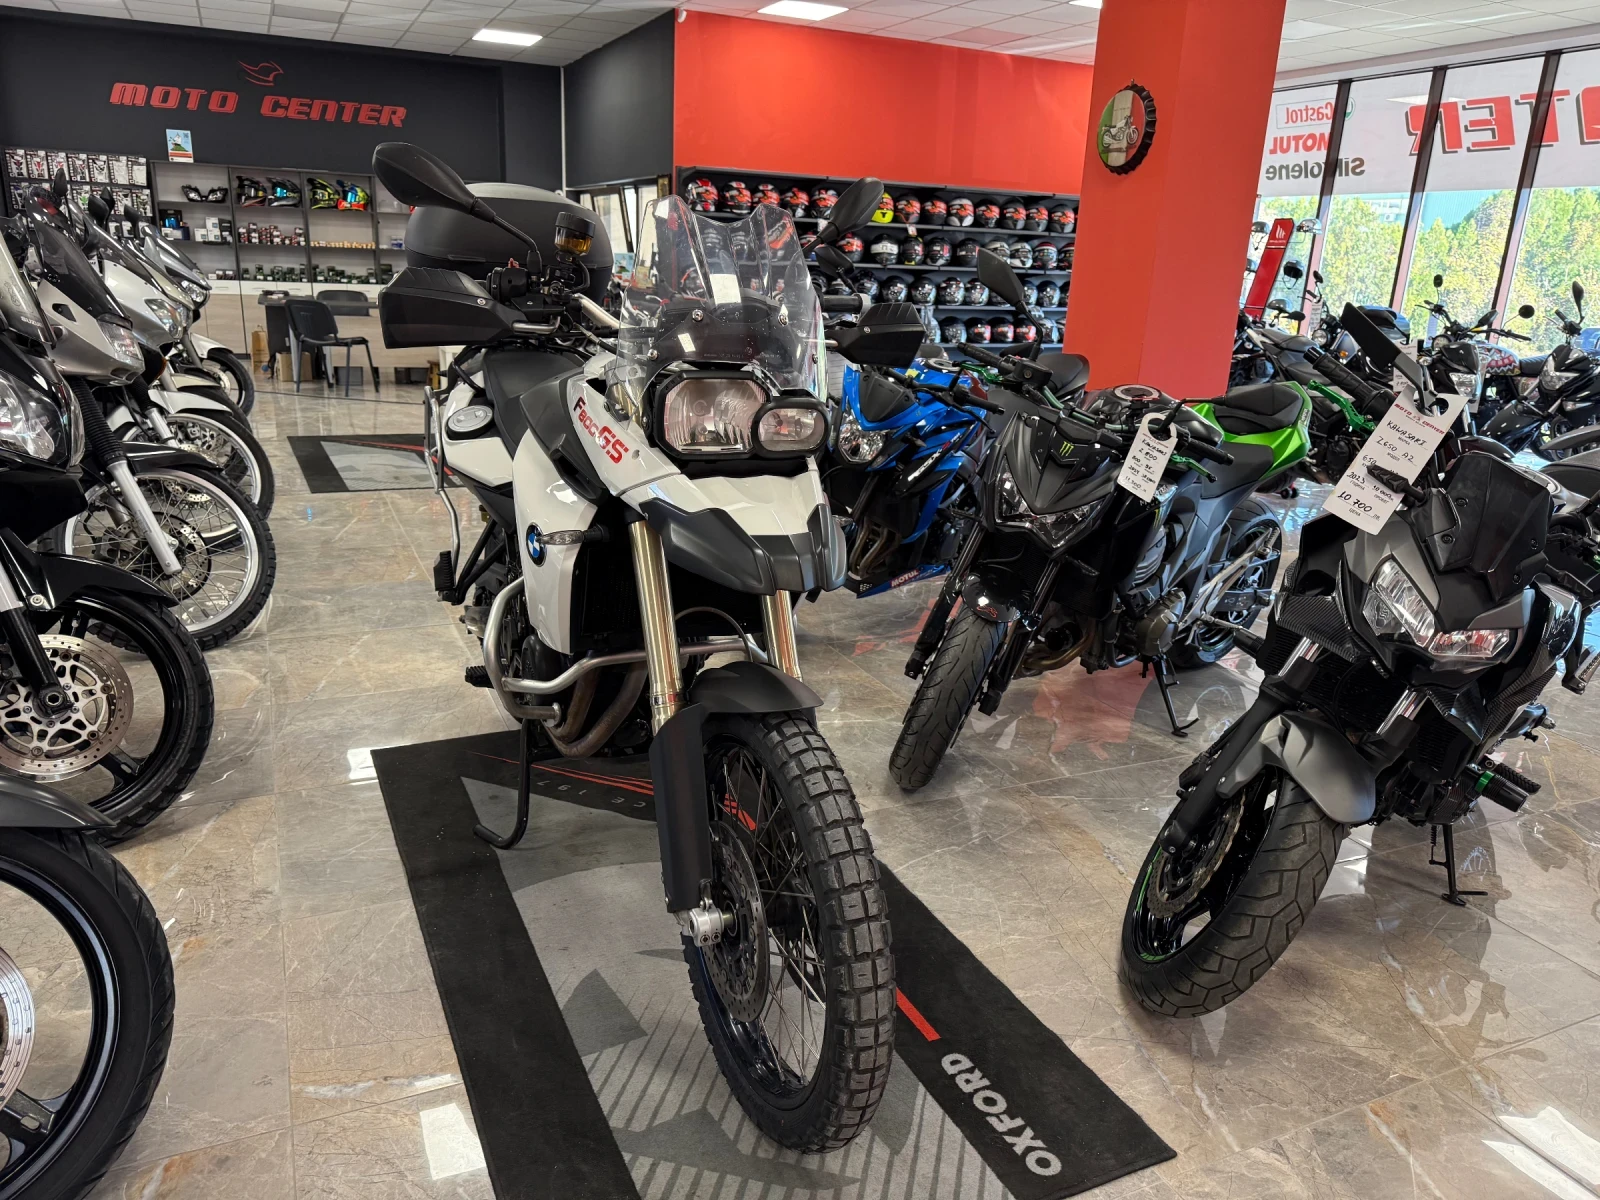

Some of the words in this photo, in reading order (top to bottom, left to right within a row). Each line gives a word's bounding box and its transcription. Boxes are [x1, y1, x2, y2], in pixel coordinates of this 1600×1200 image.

[109, 82, 238, 113] MOTO
[259, 95, 407, 127] CENTER
[1394, 403, 1412, 416] MOTO
[1421, 420, 1445, 435] CENTER
[1386, 420, 1427, 446] KAWASAKI
[1362, 454, 1377, 466] 650
[1376, 435, 1398, 452] Z650
[1401, 452, 1415, 463] A2
[1337, 490, 1352, 501] 10
[1352, 498, 1373, 512] 700
[891, 569, 920, 587] MOTUL
[941, 1052, 1063, 1176] OXFORD
